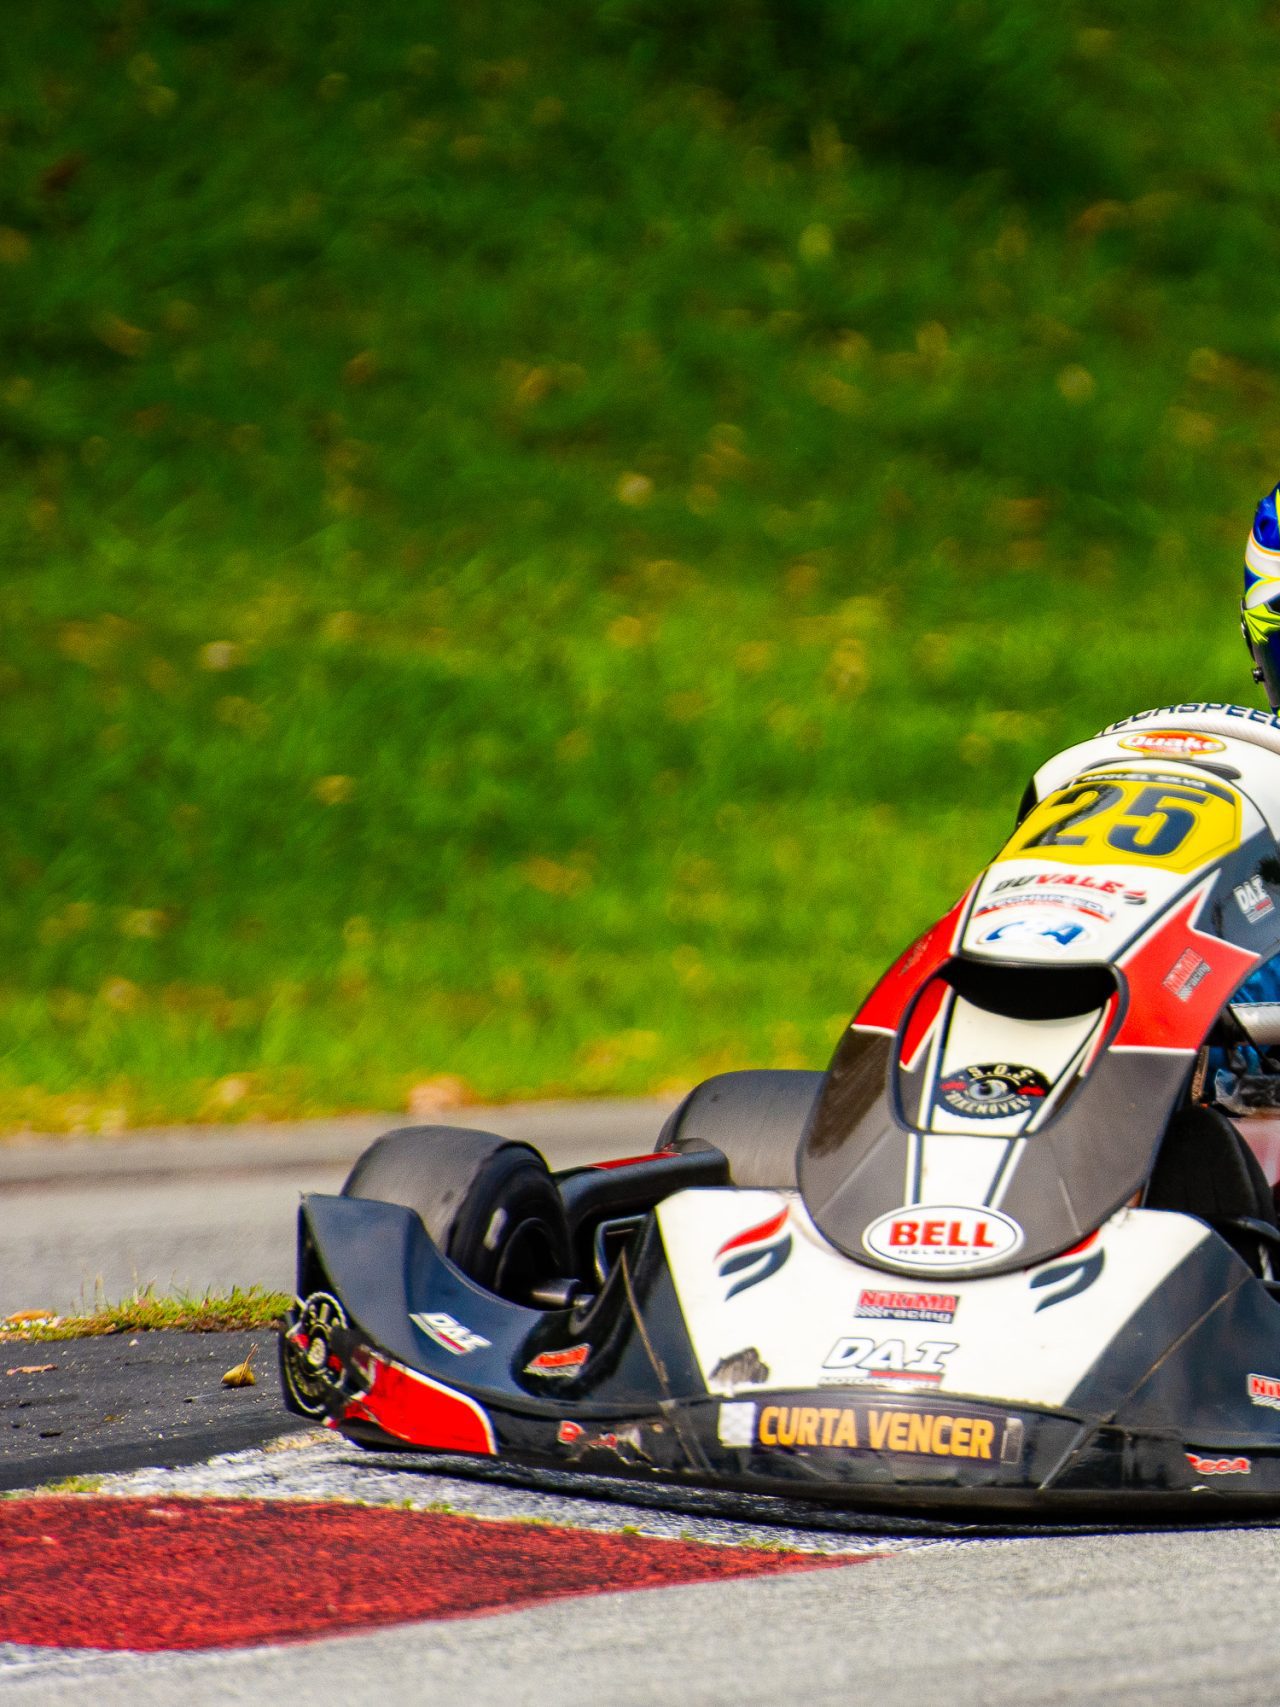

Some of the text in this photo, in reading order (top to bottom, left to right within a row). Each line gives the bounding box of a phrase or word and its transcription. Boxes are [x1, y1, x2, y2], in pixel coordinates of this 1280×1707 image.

[1019, 782, 1209, 857] 25
[991, 874, 1124, 894] DUVALE
[889, 1221, 994, 1248] BELL
[884, 1307, 951, 1323] racing
[822, 1337, 960, 1373] DAI
[758, 1405, 995, 1460] CURTA VENCER
